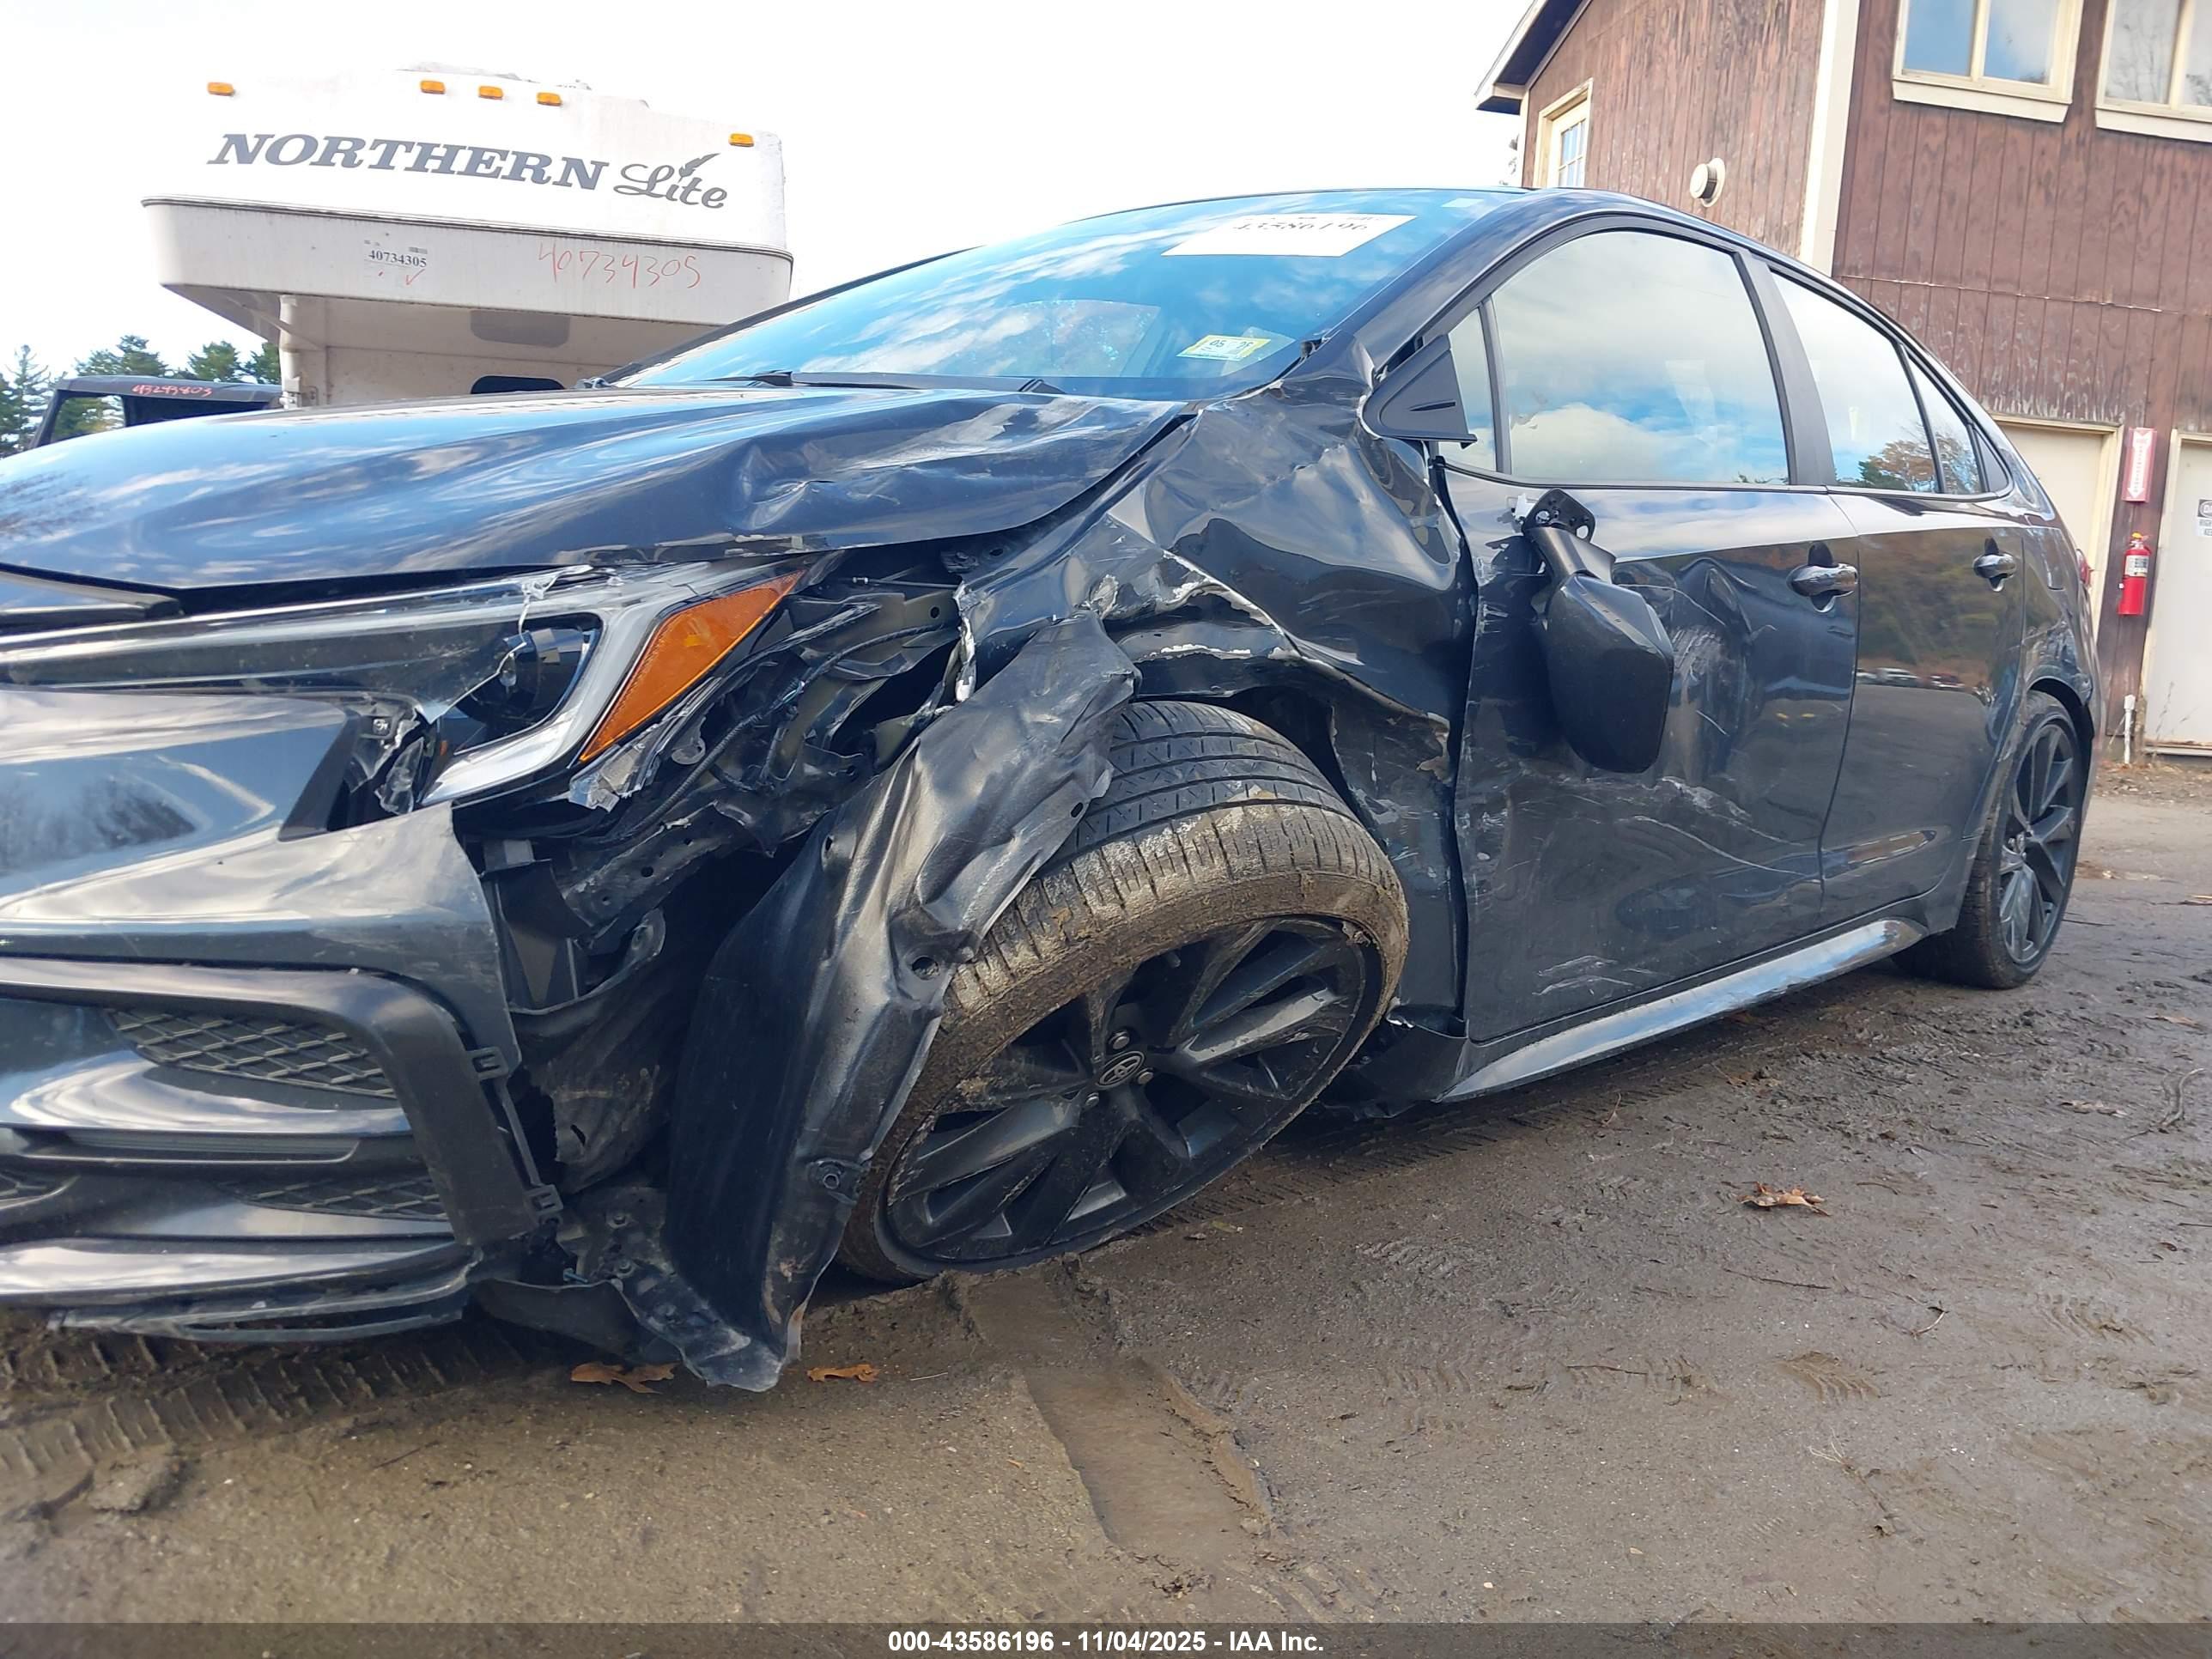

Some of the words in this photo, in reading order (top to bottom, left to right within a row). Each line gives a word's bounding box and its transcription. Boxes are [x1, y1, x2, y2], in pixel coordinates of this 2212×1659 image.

[206, 133, 610, 191] NORTHERN
[613, 153, 727, 209] Lite
[368, 250, 428, 268] 40734305
[538, 241, 701, 289] 40734305
